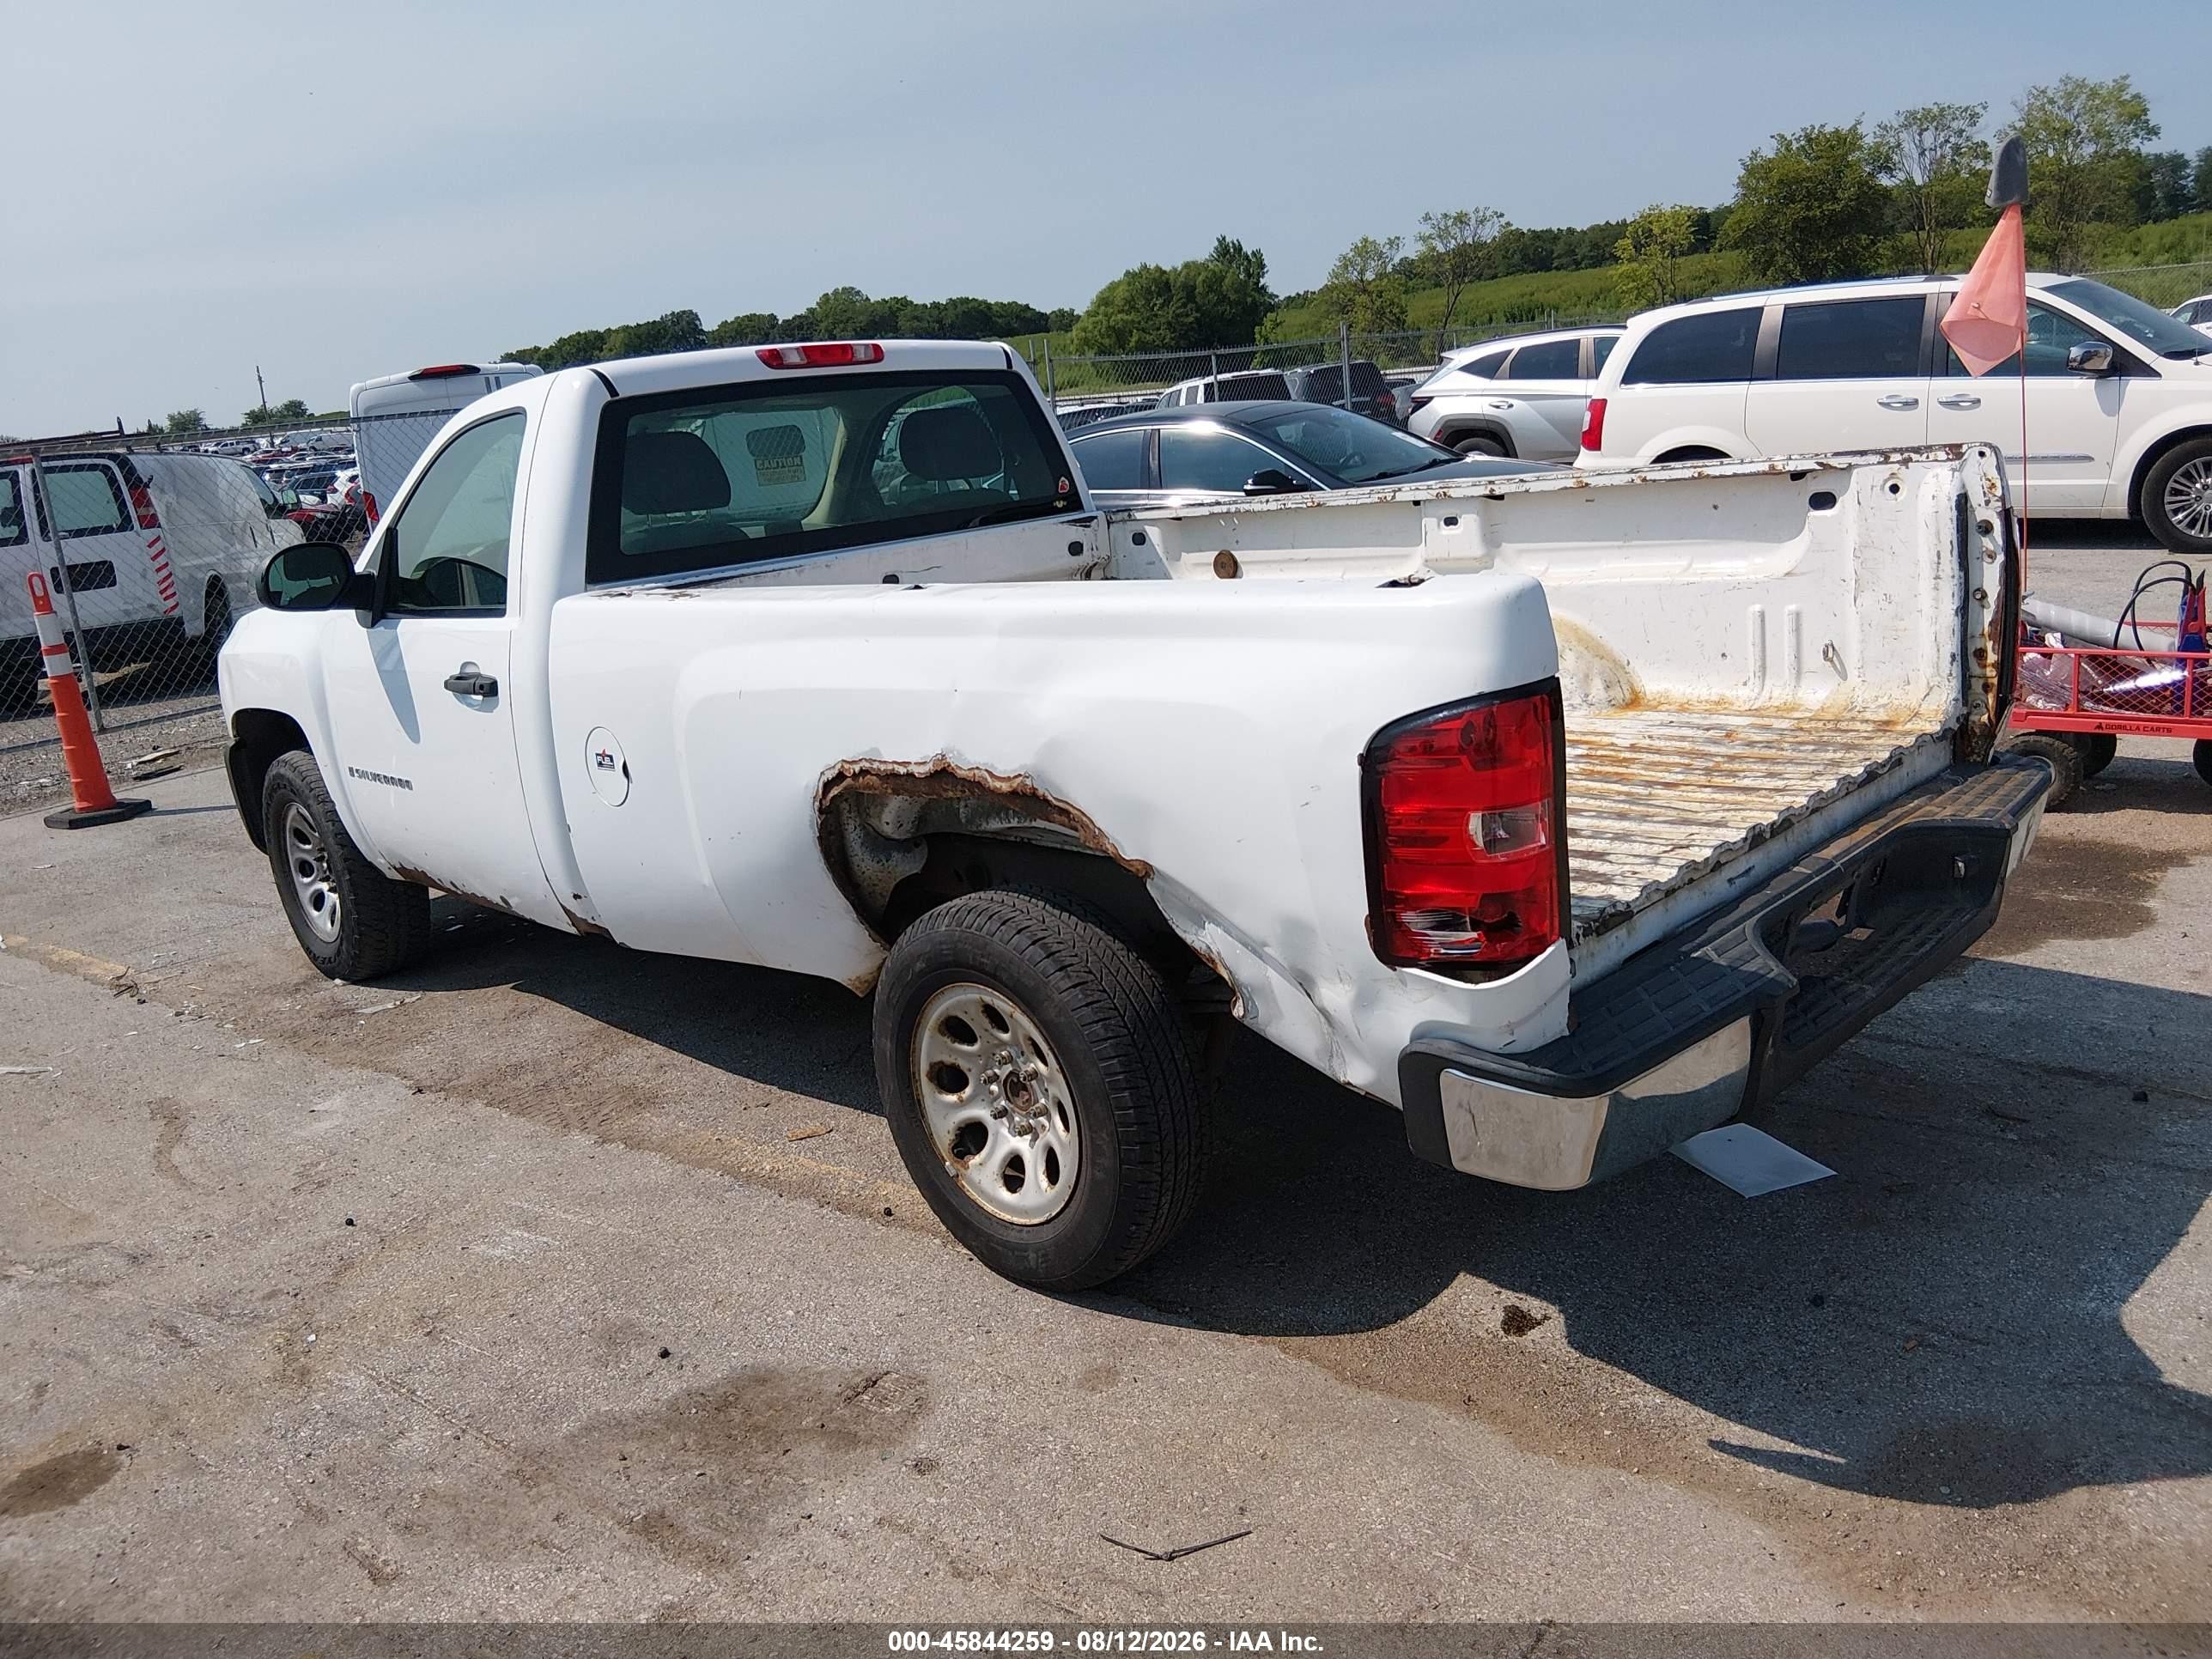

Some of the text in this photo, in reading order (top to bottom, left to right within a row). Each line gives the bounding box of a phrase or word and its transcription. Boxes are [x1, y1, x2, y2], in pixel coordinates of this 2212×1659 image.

[756, 456, 801, 470] CAUTION
[2105, 723, 2141, 732] GORILLA
[355, 768, 414, 791] SILVERADO
